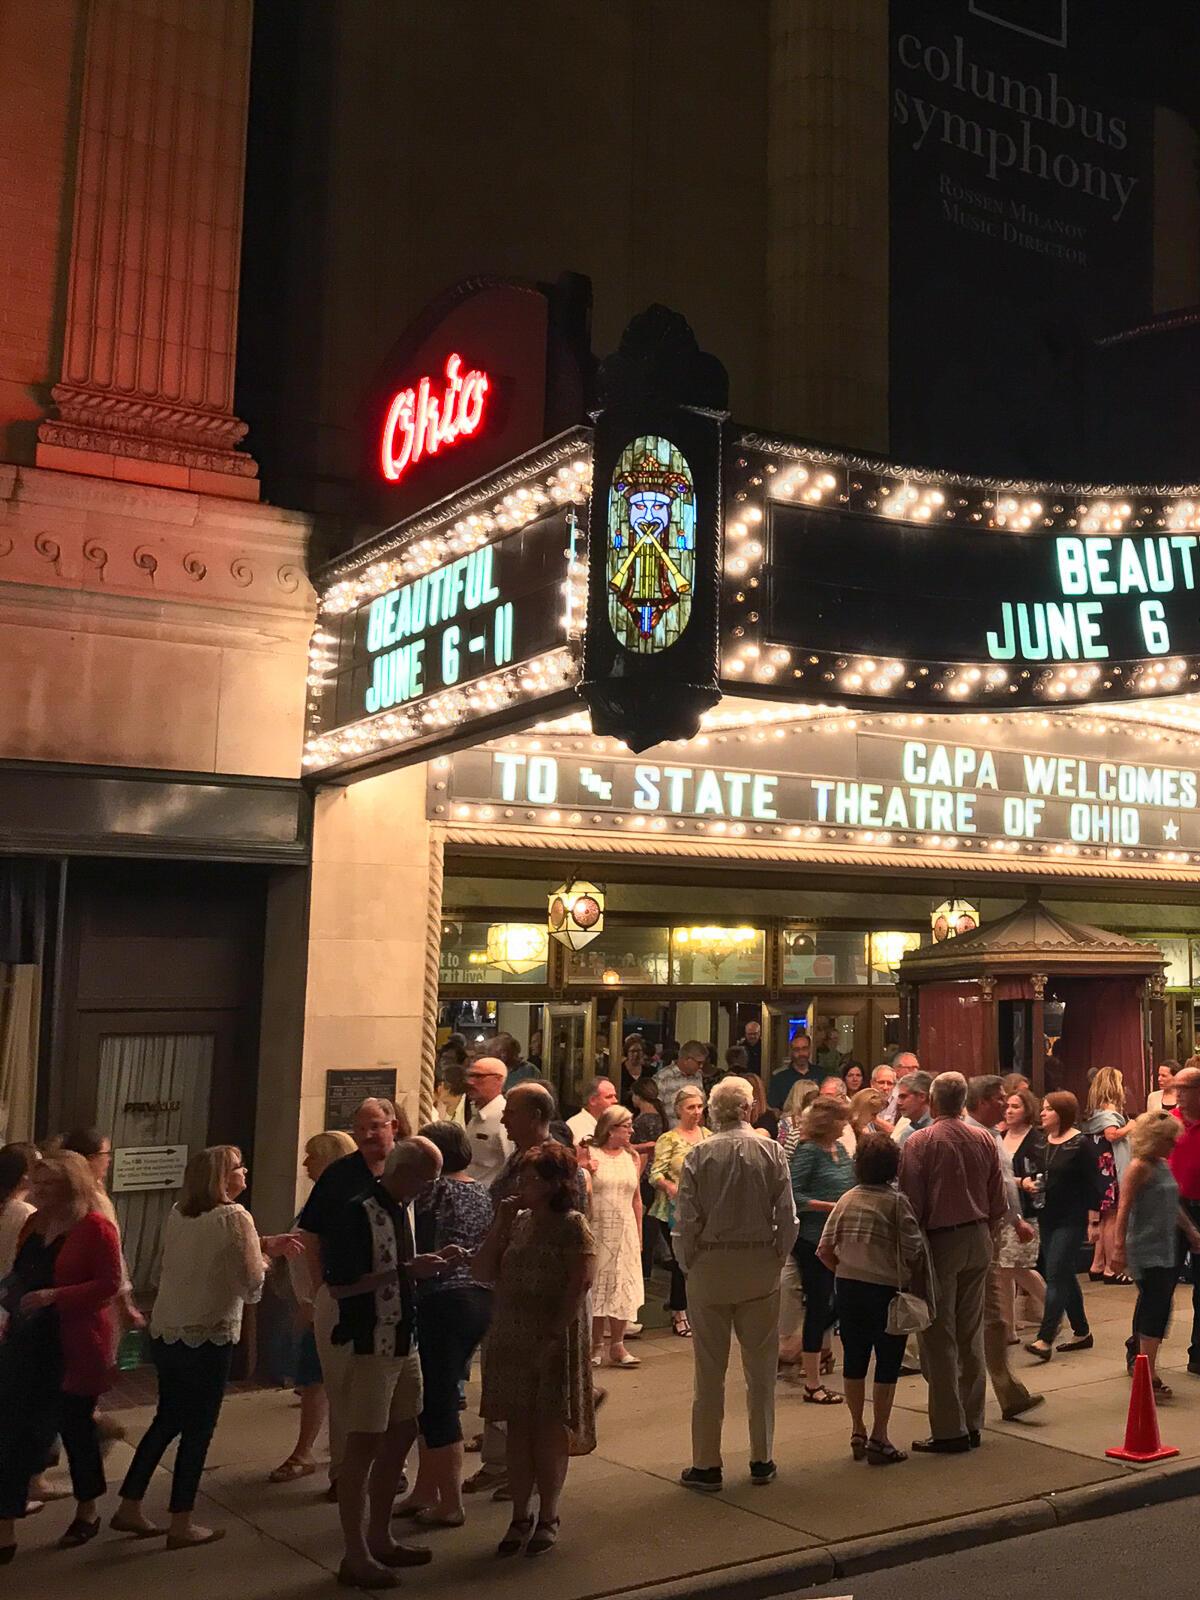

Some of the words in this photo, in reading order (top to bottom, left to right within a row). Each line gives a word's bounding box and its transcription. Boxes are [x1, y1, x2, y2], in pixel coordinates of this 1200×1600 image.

[898, 34, 1129, 150] columbus
[893, 88, 1139, 222] symphony
[381, 353, 488, 480] Ohio
[366, 544, 500, 653] BEAUTIFUL
[986, 601, 1110, 660] JUNE
[1139, 600, 1171, 655] 6
[365, 638, 426, 714] JUNE
[494, 751, 559, 804] TO
[633, 764, 779, 820] STATE
[810, 779, 977, 833] THEATRE
[1003, 796, 1047, 838] OF
[1070, 801, 1141, 845] OHIO
[902, 741, 999, 790] CAPA
[1023, 754, 1198, 809] WELCOMES
